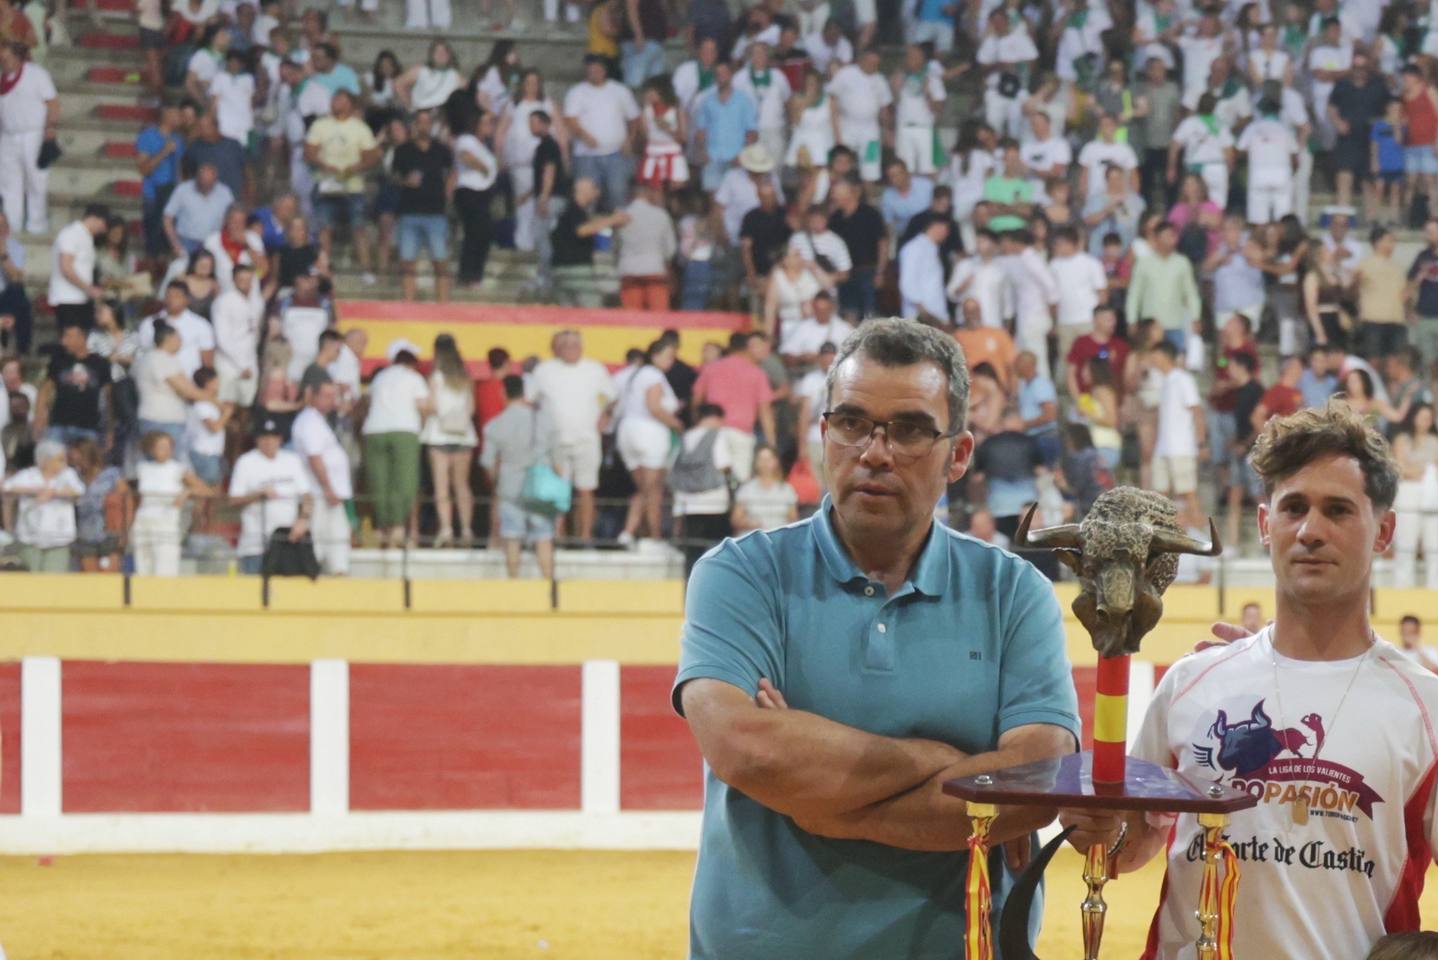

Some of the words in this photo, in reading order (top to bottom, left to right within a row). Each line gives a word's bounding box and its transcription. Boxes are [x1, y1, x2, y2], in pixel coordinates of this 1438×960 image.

[1268, 767, 1278, 775] LA
[1280, 765, 1293, 774] LIGA
[1294, 765, 1302, 773] DE
[1303, 765, 1315, 773] LOS
[1316, 767, 1351, 784] VALIENTES
[1221, 834, 1269, 862] orte
[1273, 837, 1296, 866] de
